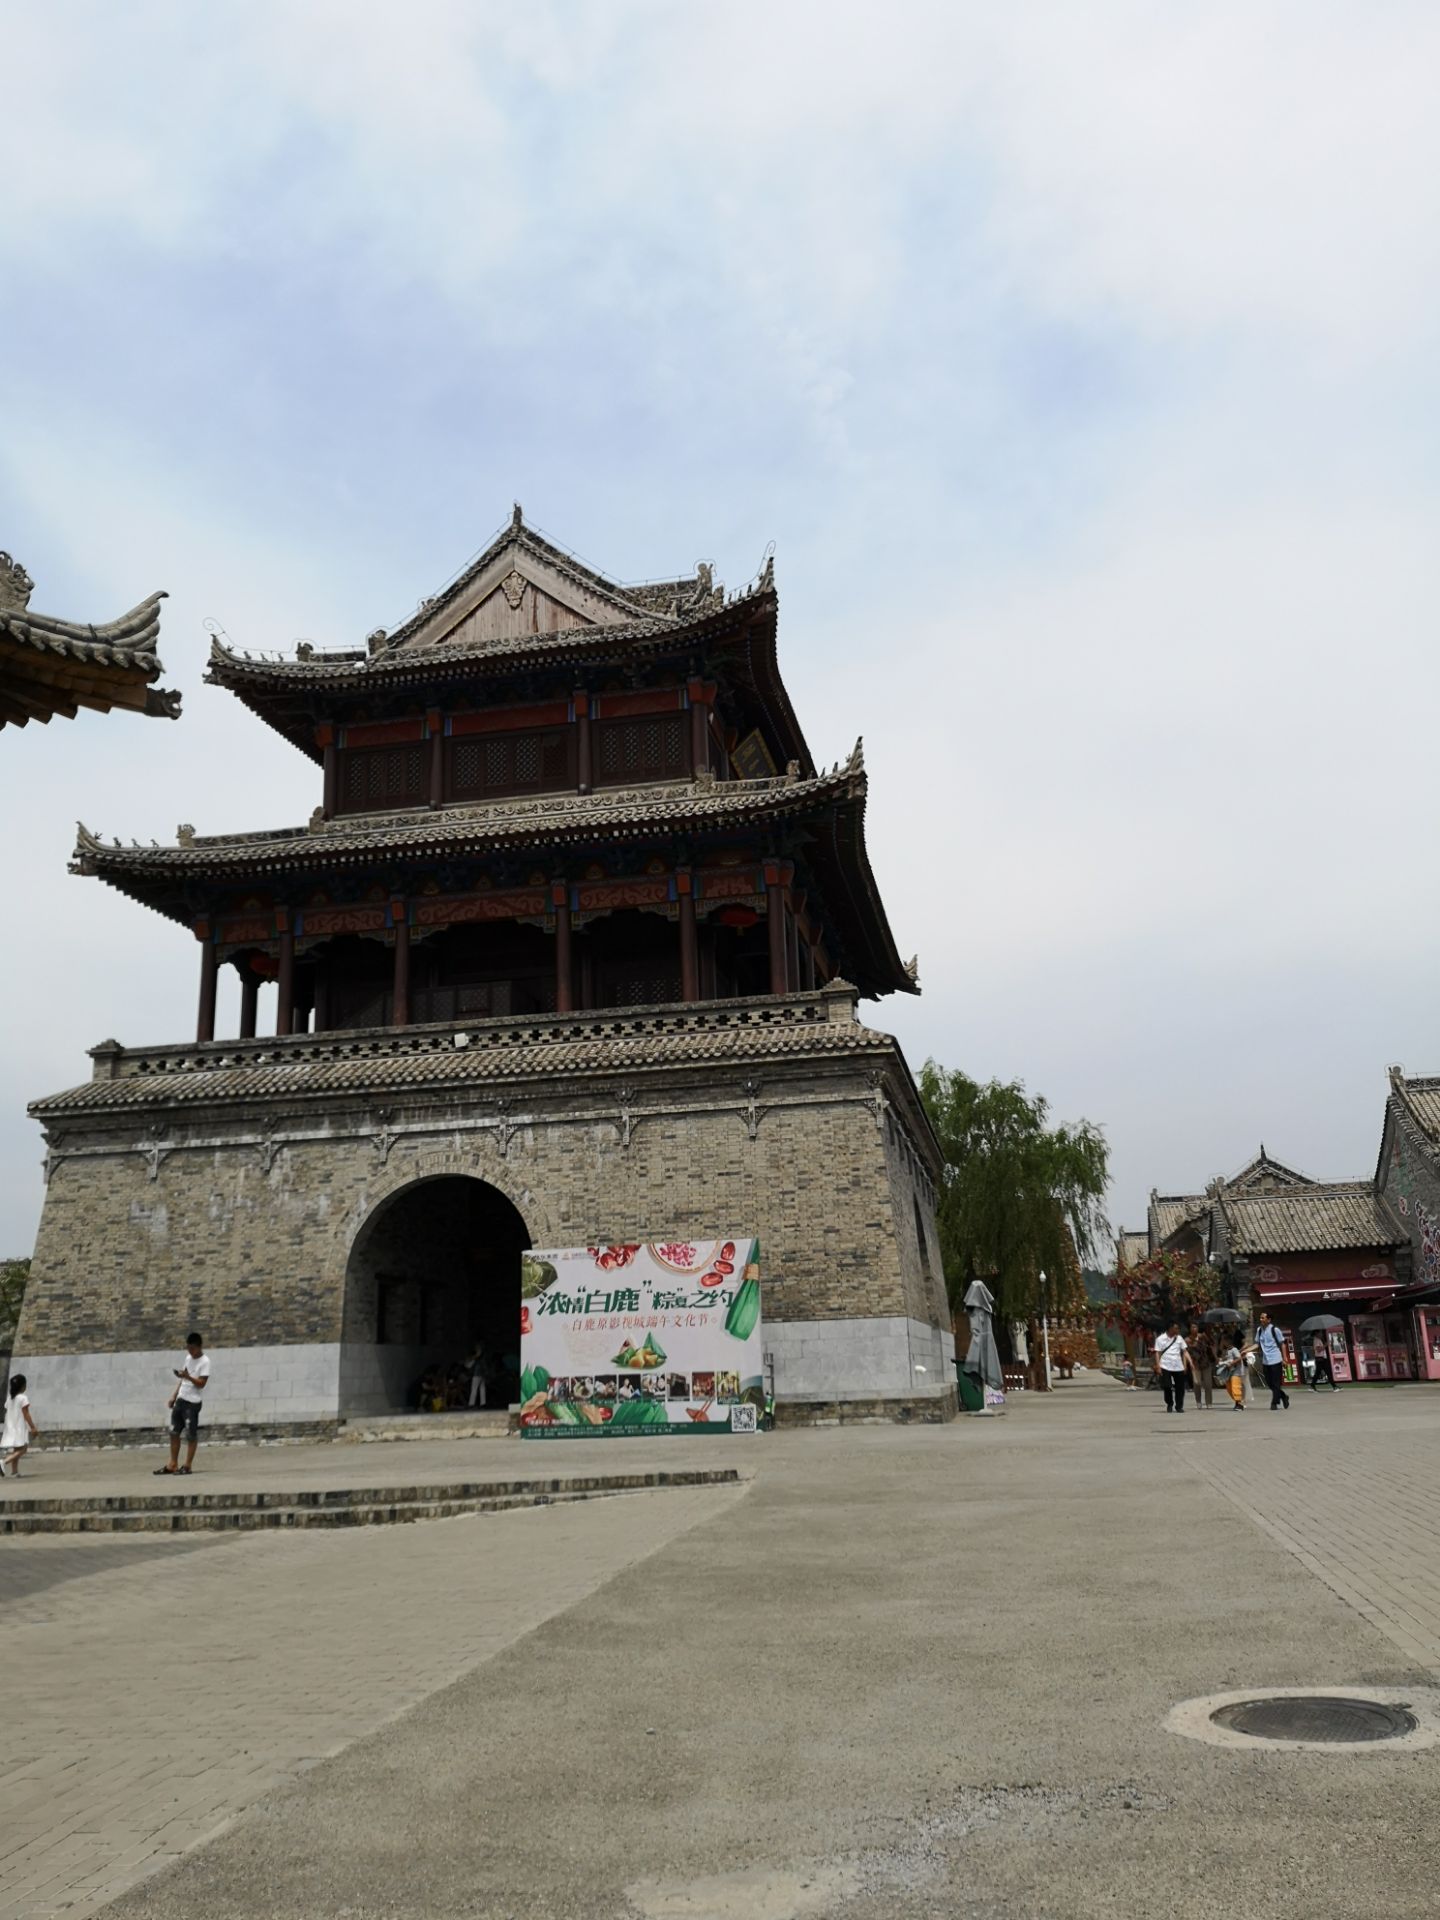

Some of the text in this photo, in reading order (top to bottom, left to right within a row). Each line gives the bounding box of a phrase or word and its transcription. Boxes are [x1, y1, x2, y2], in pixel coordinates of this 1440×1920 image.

[572, 1313, 708, 1331] 白鹿原影视城端午文化节
